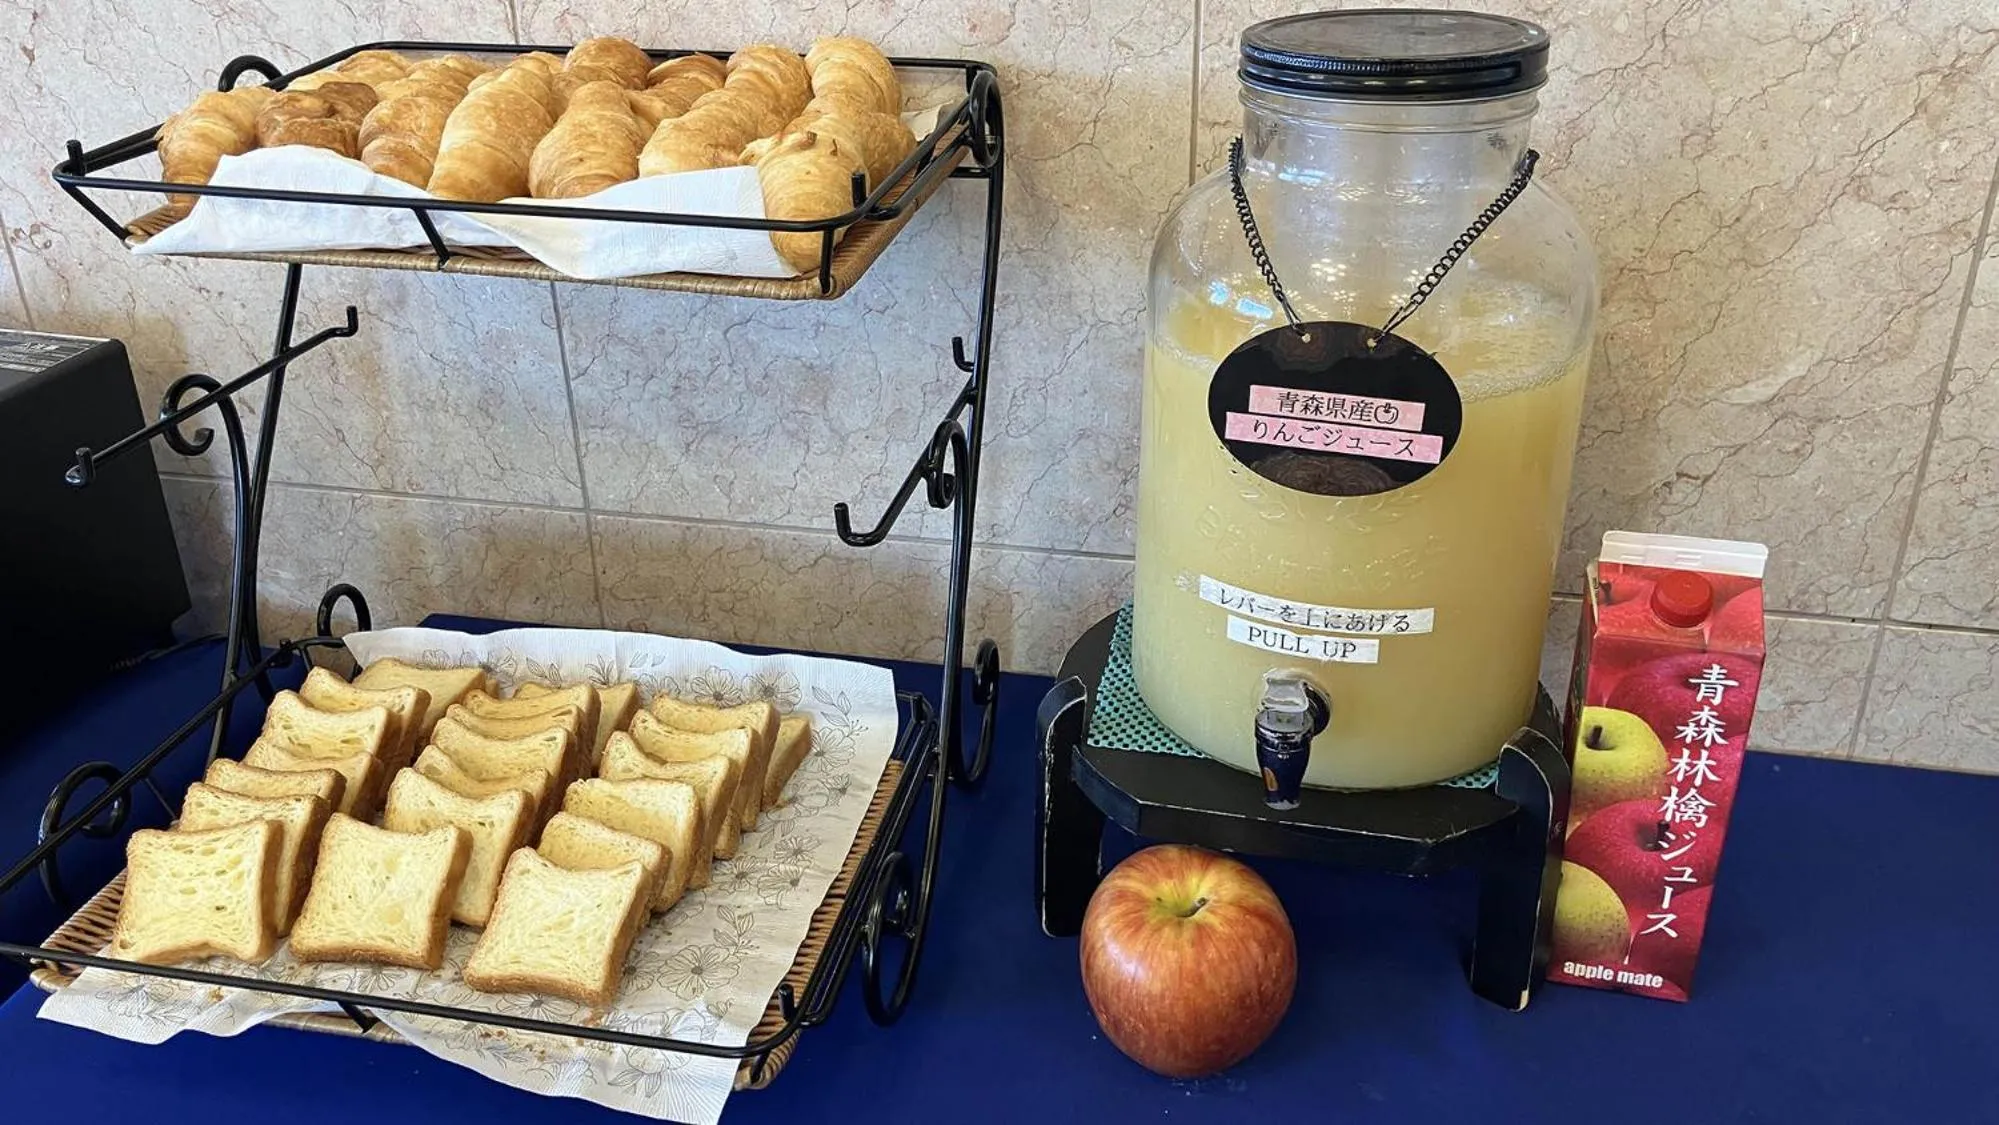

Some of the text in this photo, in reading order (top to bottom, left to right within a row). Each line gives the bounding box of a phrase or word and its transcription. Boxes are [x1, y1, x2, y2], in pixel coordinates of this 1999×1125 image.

[1277, 391, 1374, 423] 青森県産
[1253, 418, 1415, 457] りんごジュース
[1219, 588, 1411, 633] レバーを上にあげる
[1248, 626, 1357, 658] PULL UP
[1640, 663, 1740, 939] 青森林檎ジュース
[1563, 961, 1664, 988] apple mate
